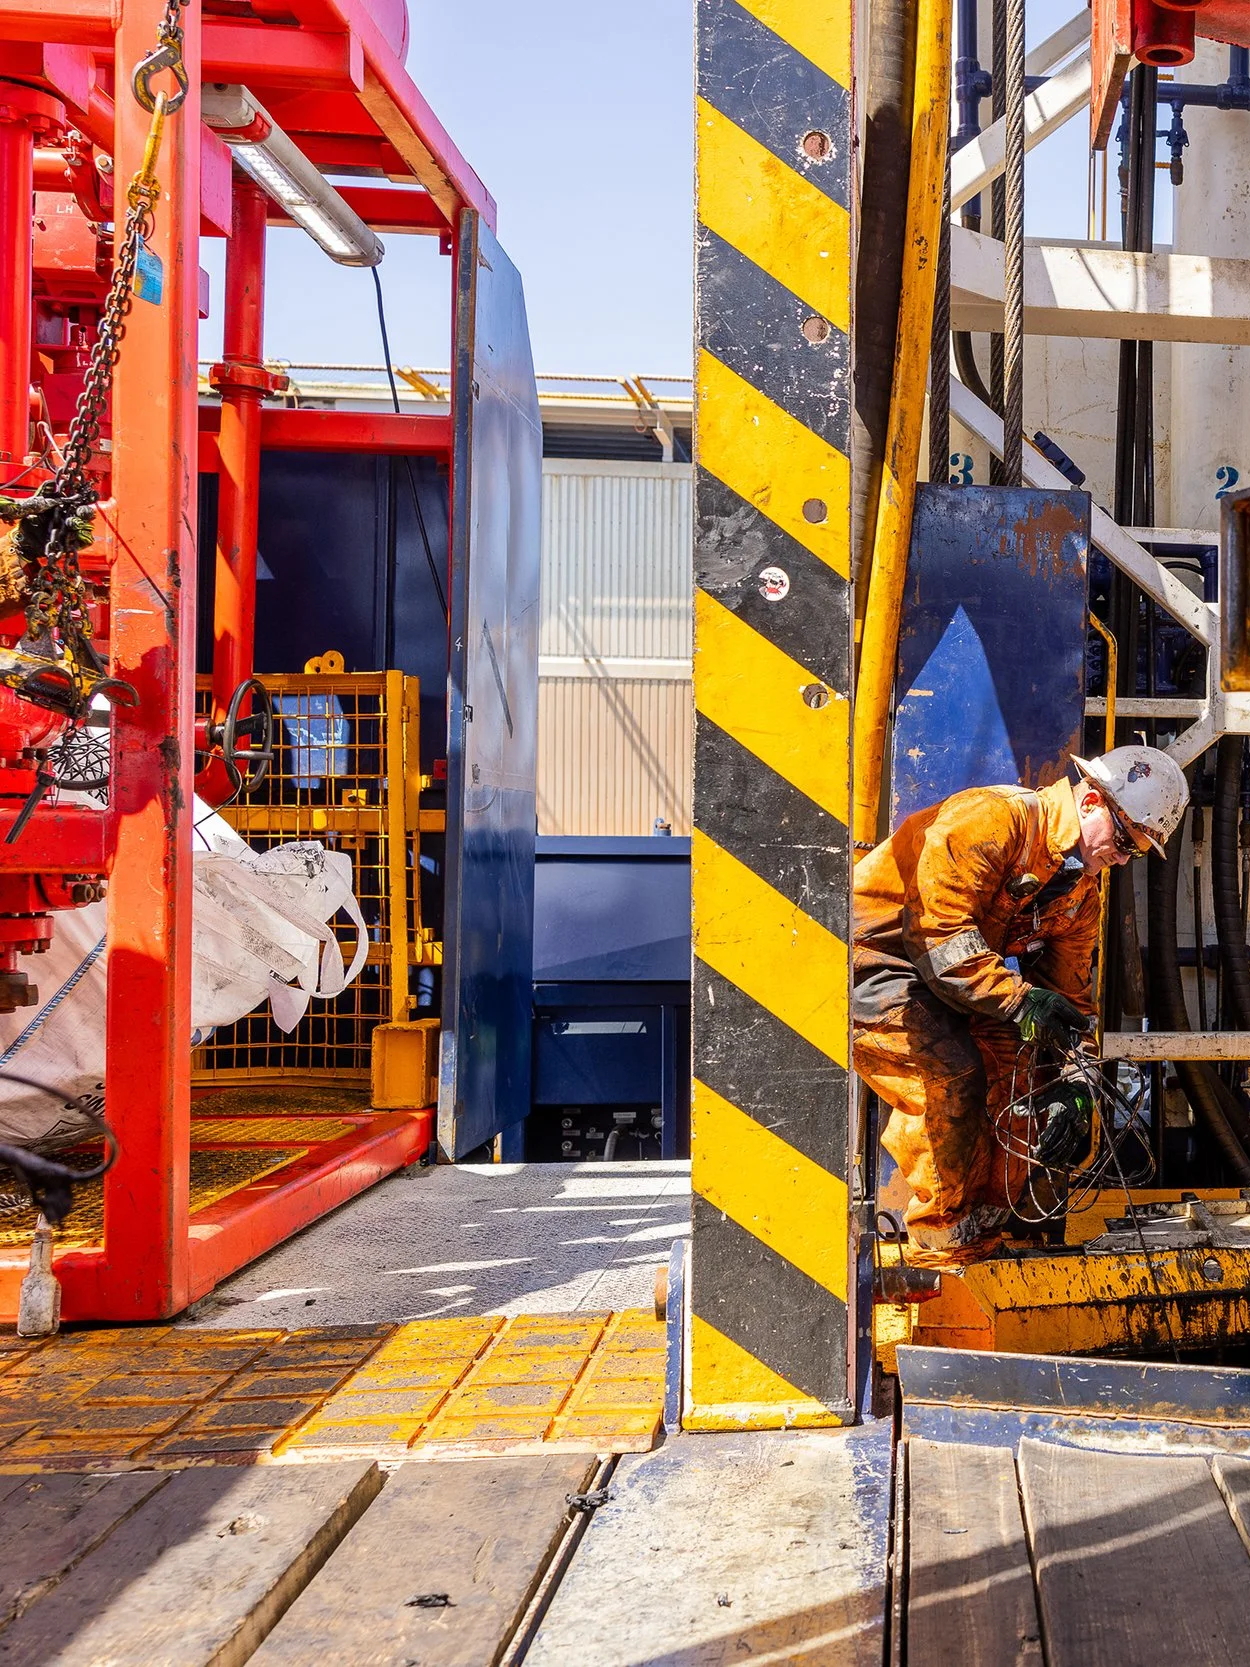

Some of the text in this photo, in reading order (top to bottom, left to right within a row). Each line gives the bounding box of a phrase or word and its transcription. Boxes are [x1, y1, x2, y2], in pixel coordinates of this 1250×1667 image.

[56, 203, 74, 214] LH
[949, 452, 974, 486] 3
[1215, 466, 1240, 500] 2
